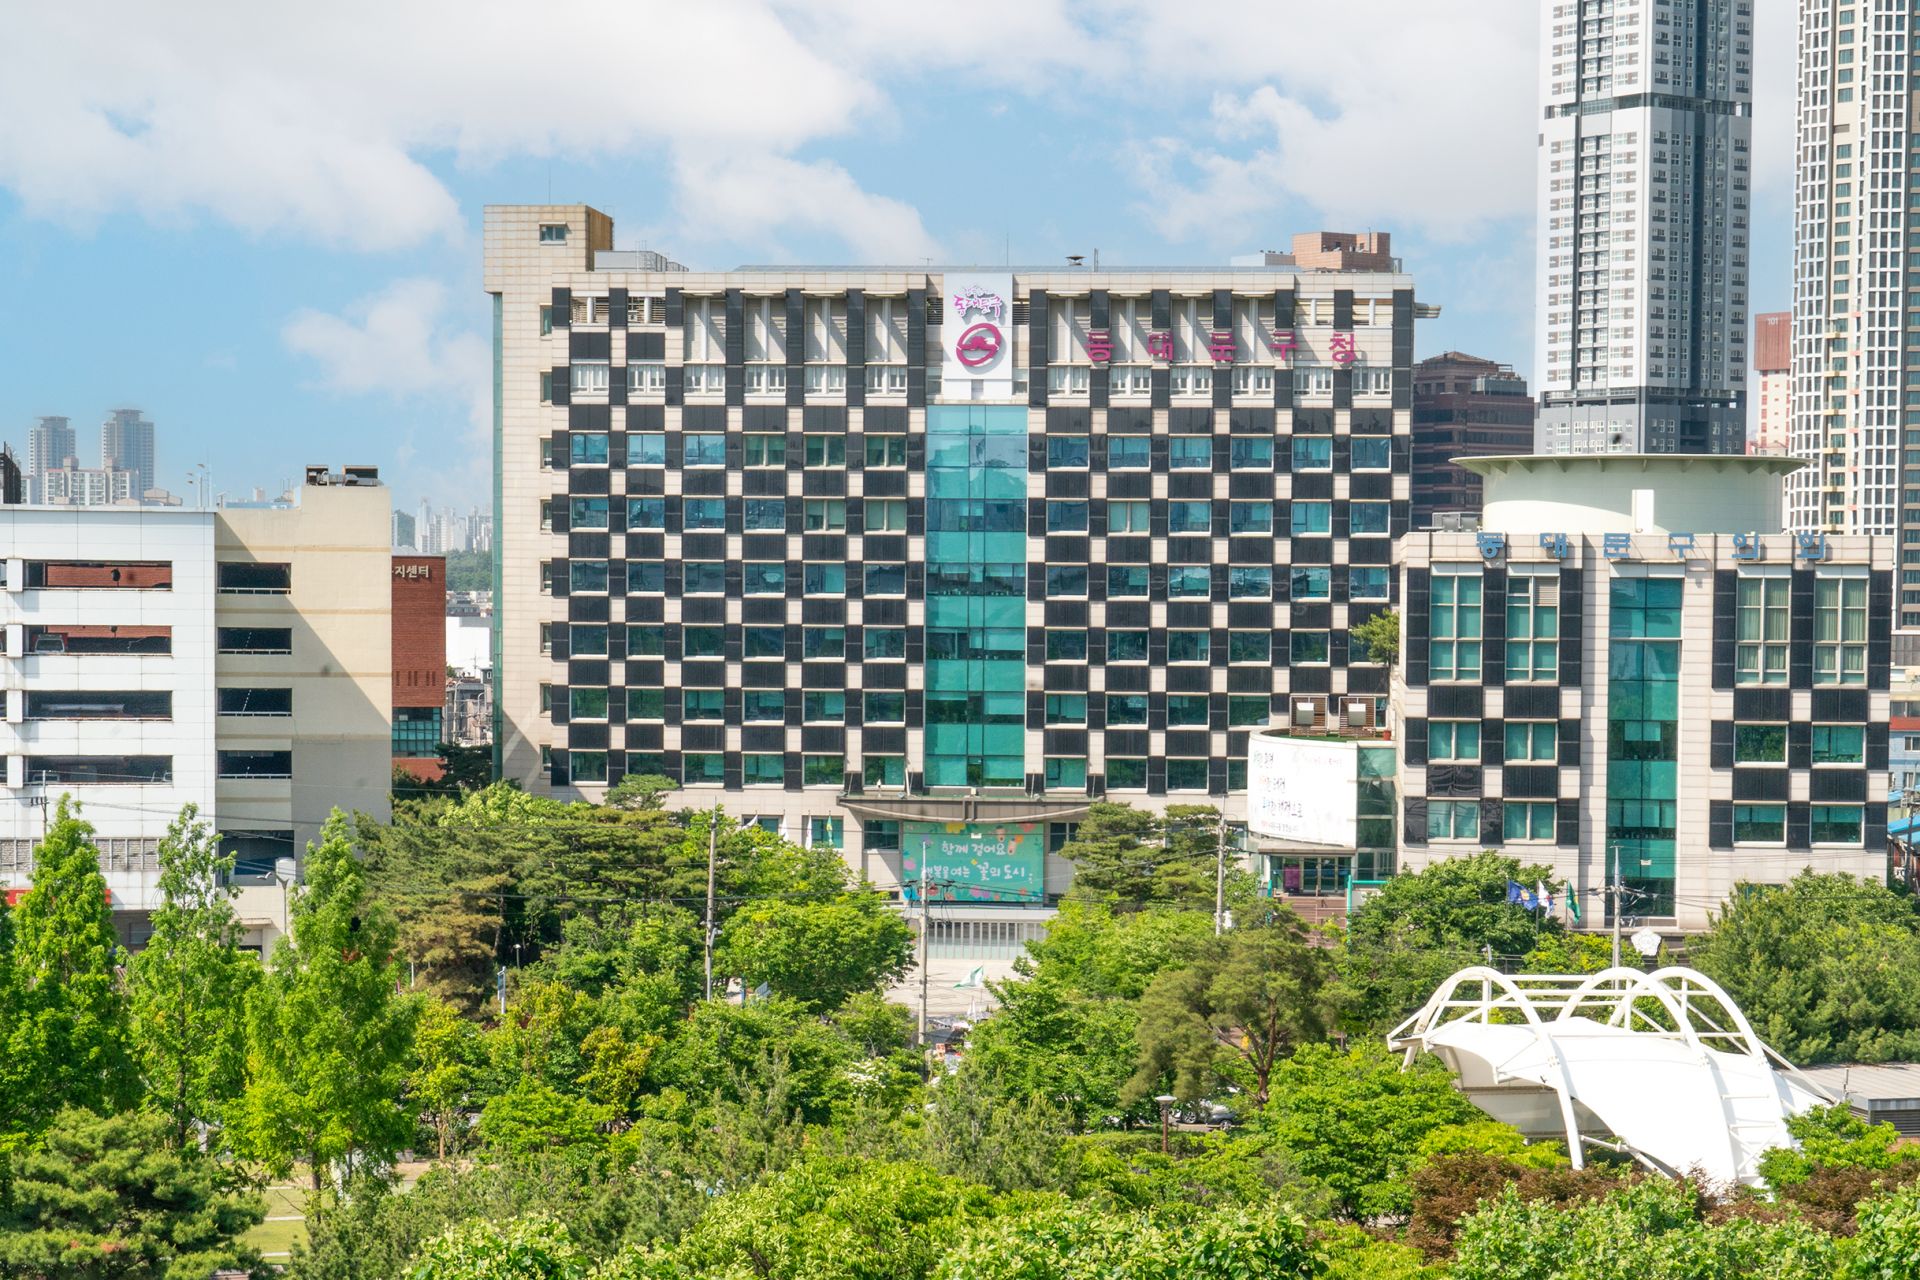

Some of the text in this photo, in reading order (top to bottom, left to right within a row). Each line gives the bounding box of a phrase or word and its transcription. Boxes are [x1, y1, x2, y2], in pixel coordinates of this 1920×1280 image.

[1085, 331, 1356, 363] 동대문구청
[1476, 531, 1825, 559] 동대문구의회
[391, 564, 429, 578] 지센터
[942, 840, 1006, 857] 함께 걸어요
[976, 861, 1001, 881] 꽃의
[1004, 864, 1025, 880] 도시
